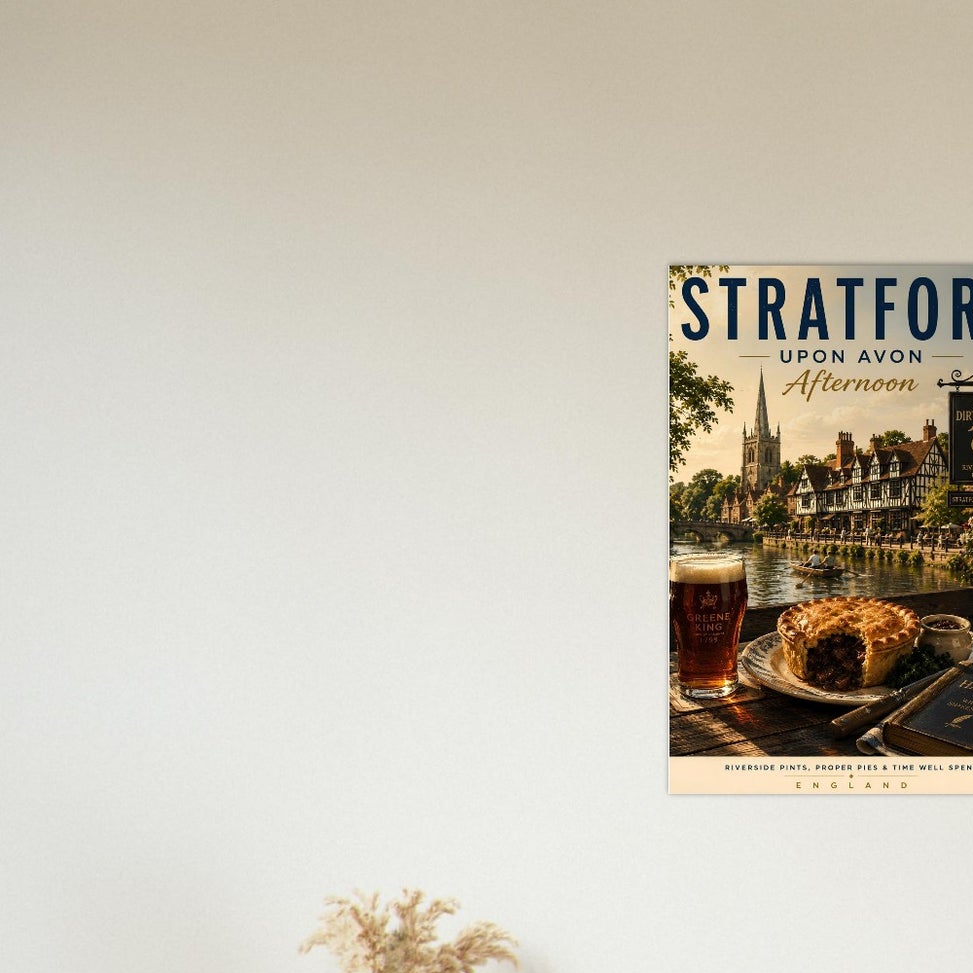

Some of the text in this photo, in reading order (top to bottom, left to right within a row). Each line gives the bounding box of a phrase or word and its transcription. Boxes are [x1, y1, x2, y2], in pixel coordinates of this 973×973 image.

[780, 350, 922, 363] UPON AVON
[782, 369, 918, 402] Afternoon
[687, 612, 730, 622] GREENE
[695, 623, 722, 631] KING
[780, 764, 811, 772] PINTS,
[796, 781, 908, 789] ENGLAND
